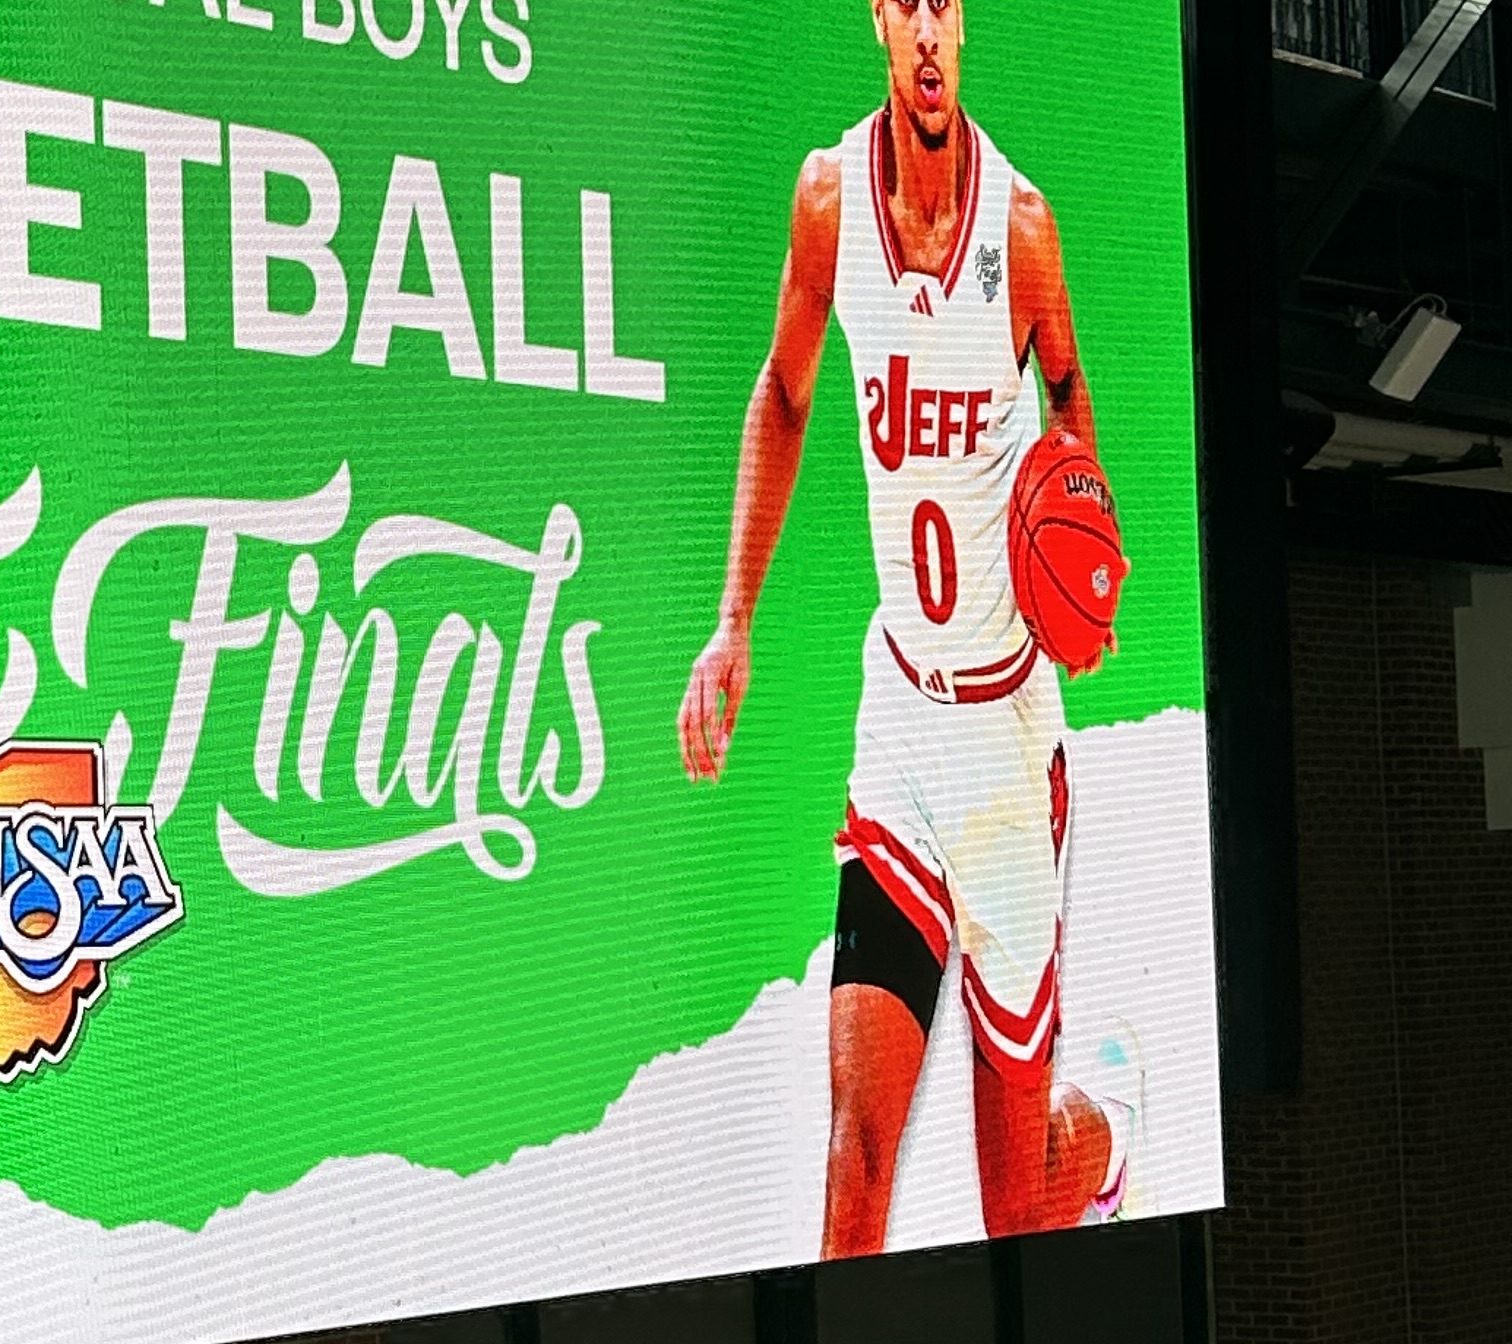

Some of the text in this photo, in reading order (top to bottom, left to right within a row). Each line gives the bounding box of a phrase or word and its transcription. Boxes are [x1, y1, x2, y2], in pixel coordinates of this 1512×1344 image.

[864, 354, 993, 472] JEFF
[911, 499, 958, 625] 0
[50, 459, 606, 898] Finals
